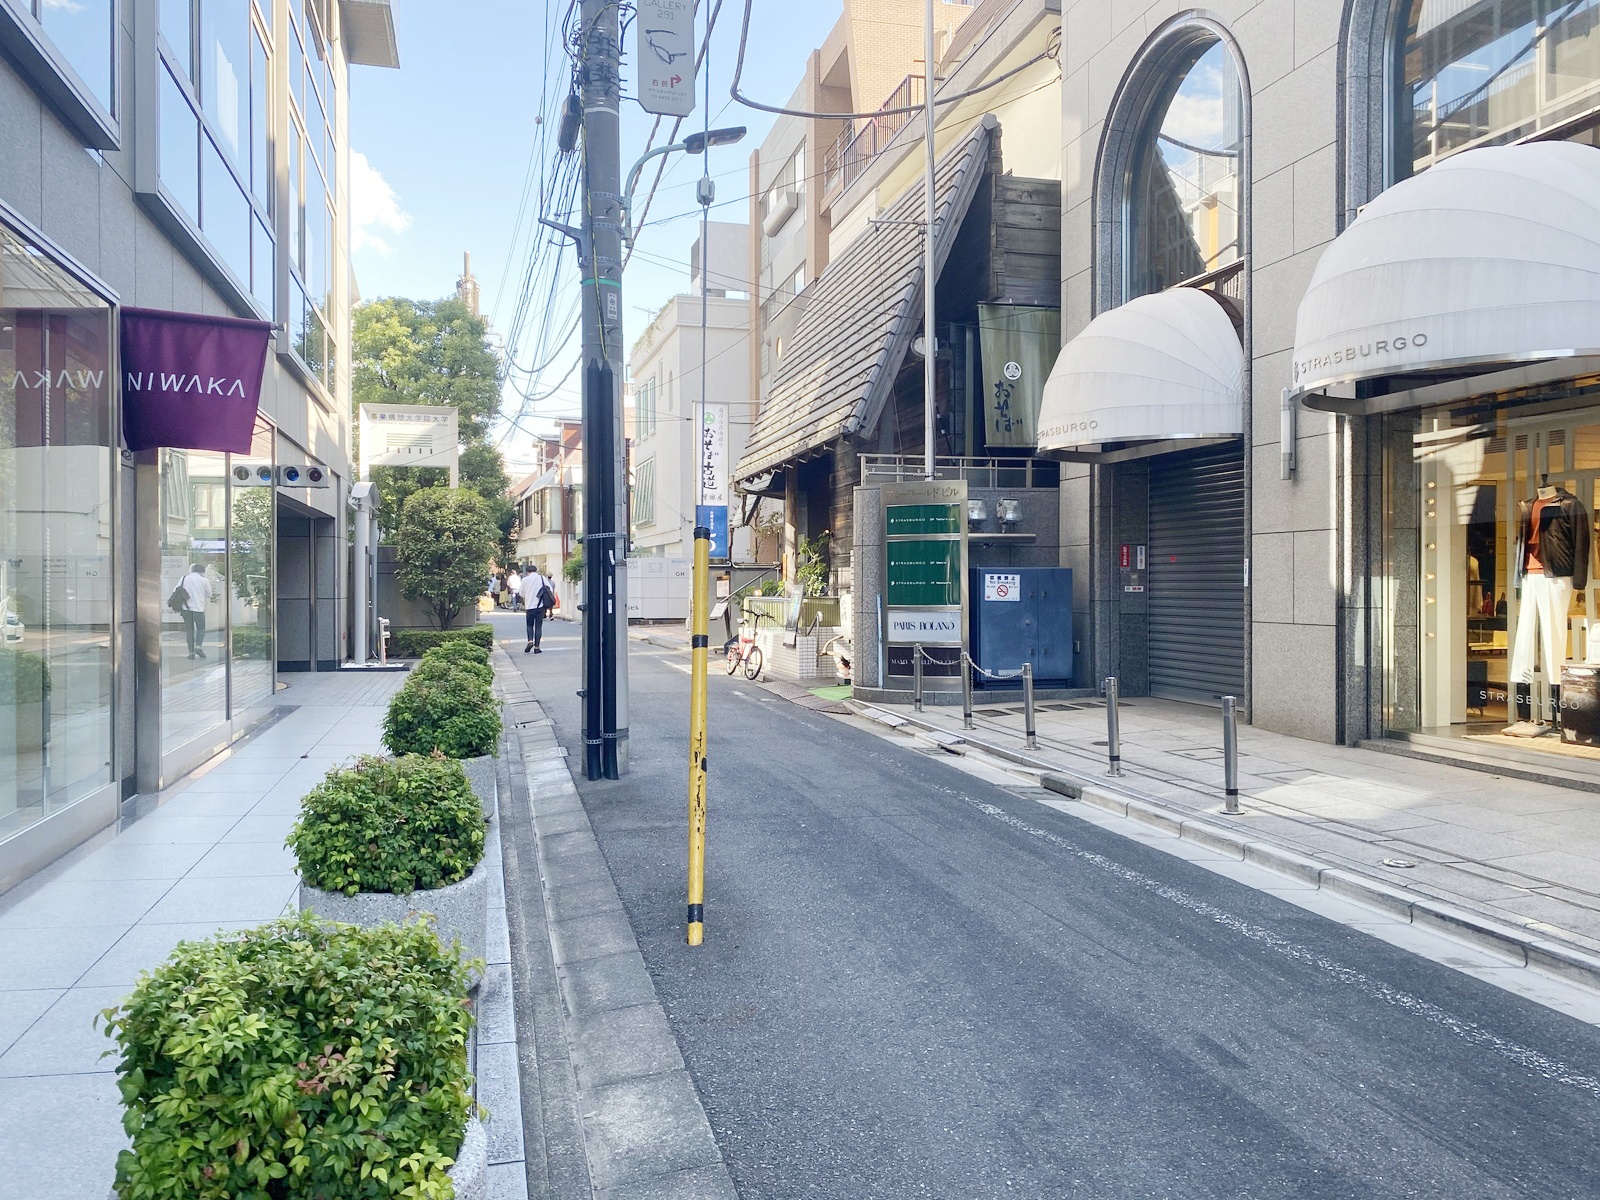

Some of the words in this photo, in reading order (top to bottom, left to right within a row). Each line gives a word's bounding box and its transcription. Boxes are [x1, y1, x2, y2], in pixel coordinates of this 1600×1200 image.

[643, 0, 688, 11] GALLERY
[657, 9, 674, 20] 291
[1301, 333, 1428, 374] STRASBURGO
[128, 371, 245, 398] NIWAKA
[893, 621, 916, 631] PARIS
[919, 621, 955, 631] ROLAND
